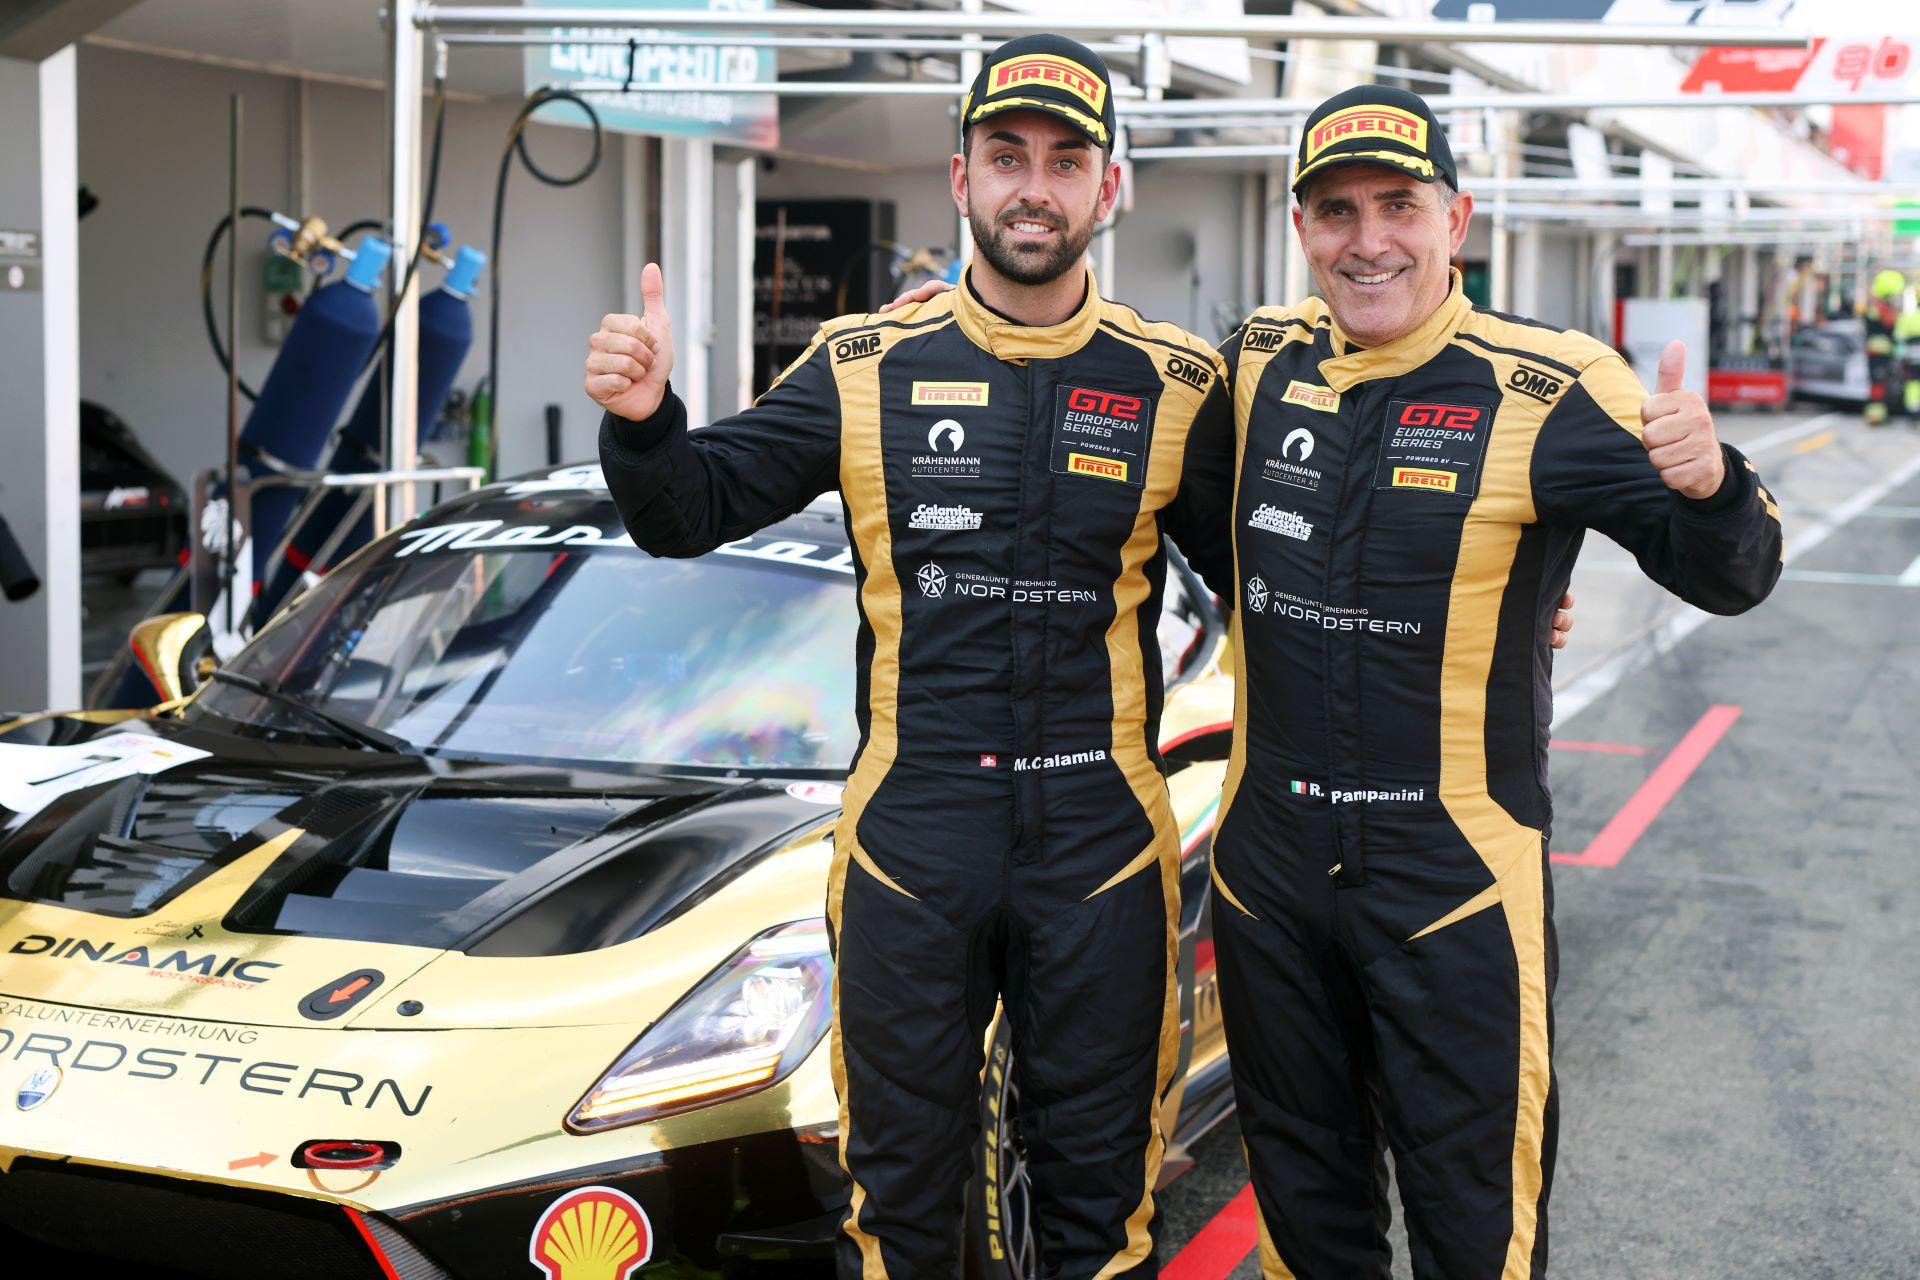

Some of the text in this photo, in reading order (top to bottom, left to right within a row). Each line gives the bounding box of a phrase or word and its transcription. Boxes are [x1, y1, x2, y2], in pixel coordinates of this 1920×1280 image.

[996, 60, 1099, 101] PIRELLI
[1313, 111, 1419, 151] PIRELLI
[836, 336, 881, 359] OMP
[1244, 331, 1285, 349] OMP
[1166, 358, 1210, 387] OMP
[918, 386, 983, 402] PIRELLI
[1510, 369, 1560, 398] OMP
[1068, 388, 1141, 420] GT2
[1289, 386, 1337, 408] PIRELLI
[1065, 411, 1139, 433] EUROPEAN
[1399, 404, 1481, 430] GT2
[1062, 421, 1113, 438] SERIES
[1395, 427, 1476, 442] EUROPEAN
[1080, 442, 1111, 452] POWERED
[1390, 438, 1443, 449] SERIES
[912, 455, 981, 465] KRÄHENMANN
[1074, 457, 1122, 477] PIRELLI
[1265, 458, 1322, 480] KRÄHENMANN
[1405, 455, 1439, 463] POWERED
[911, 466, 981, 474] AUTOCENTER AG
[1262, 468, 1319, 488] AUTOCENTER AG
[1398, 471, 1451, 488] PIRELLI
[910, 512, 983, 525] Carrosserie
[917, 503, 971, 517] Calamia
[1259, 503, 1304, 525] Calamia
[1252, 509, 1313, 535] Carrosserie
[1309, 782, 1424, 804] R. Pampanini
[7, 934, 283, 983] DINAMIC
[147, 970, 259, 991] MOTORSPORT
